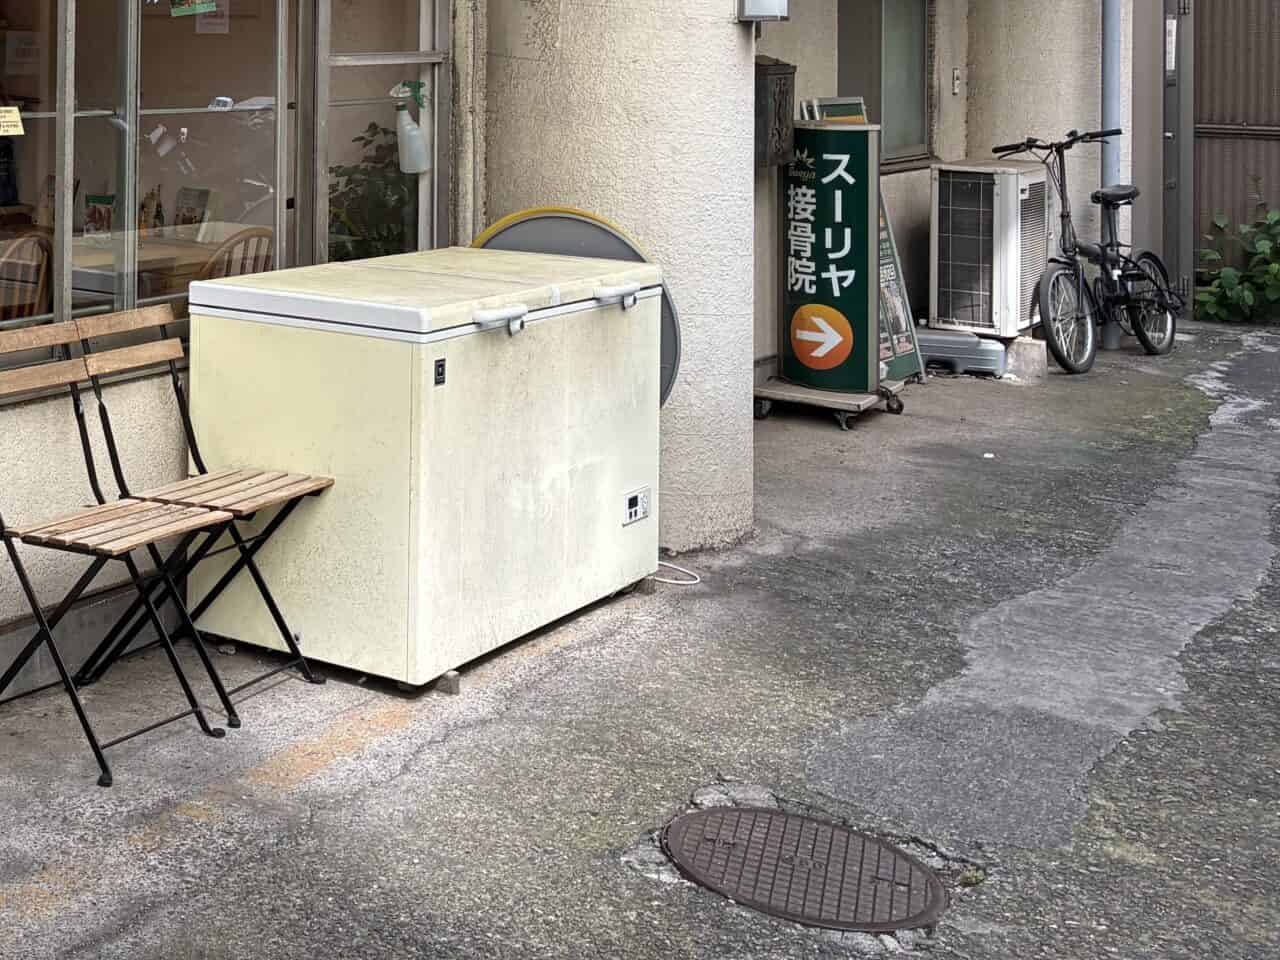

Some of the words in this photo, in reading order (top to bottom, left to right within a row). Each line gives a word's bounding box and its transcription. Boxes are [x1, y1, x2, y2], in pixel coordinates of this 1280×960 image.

[787, 184, 817, 295] 接骨院
[821, 153, 856, 297] スーリヤ
